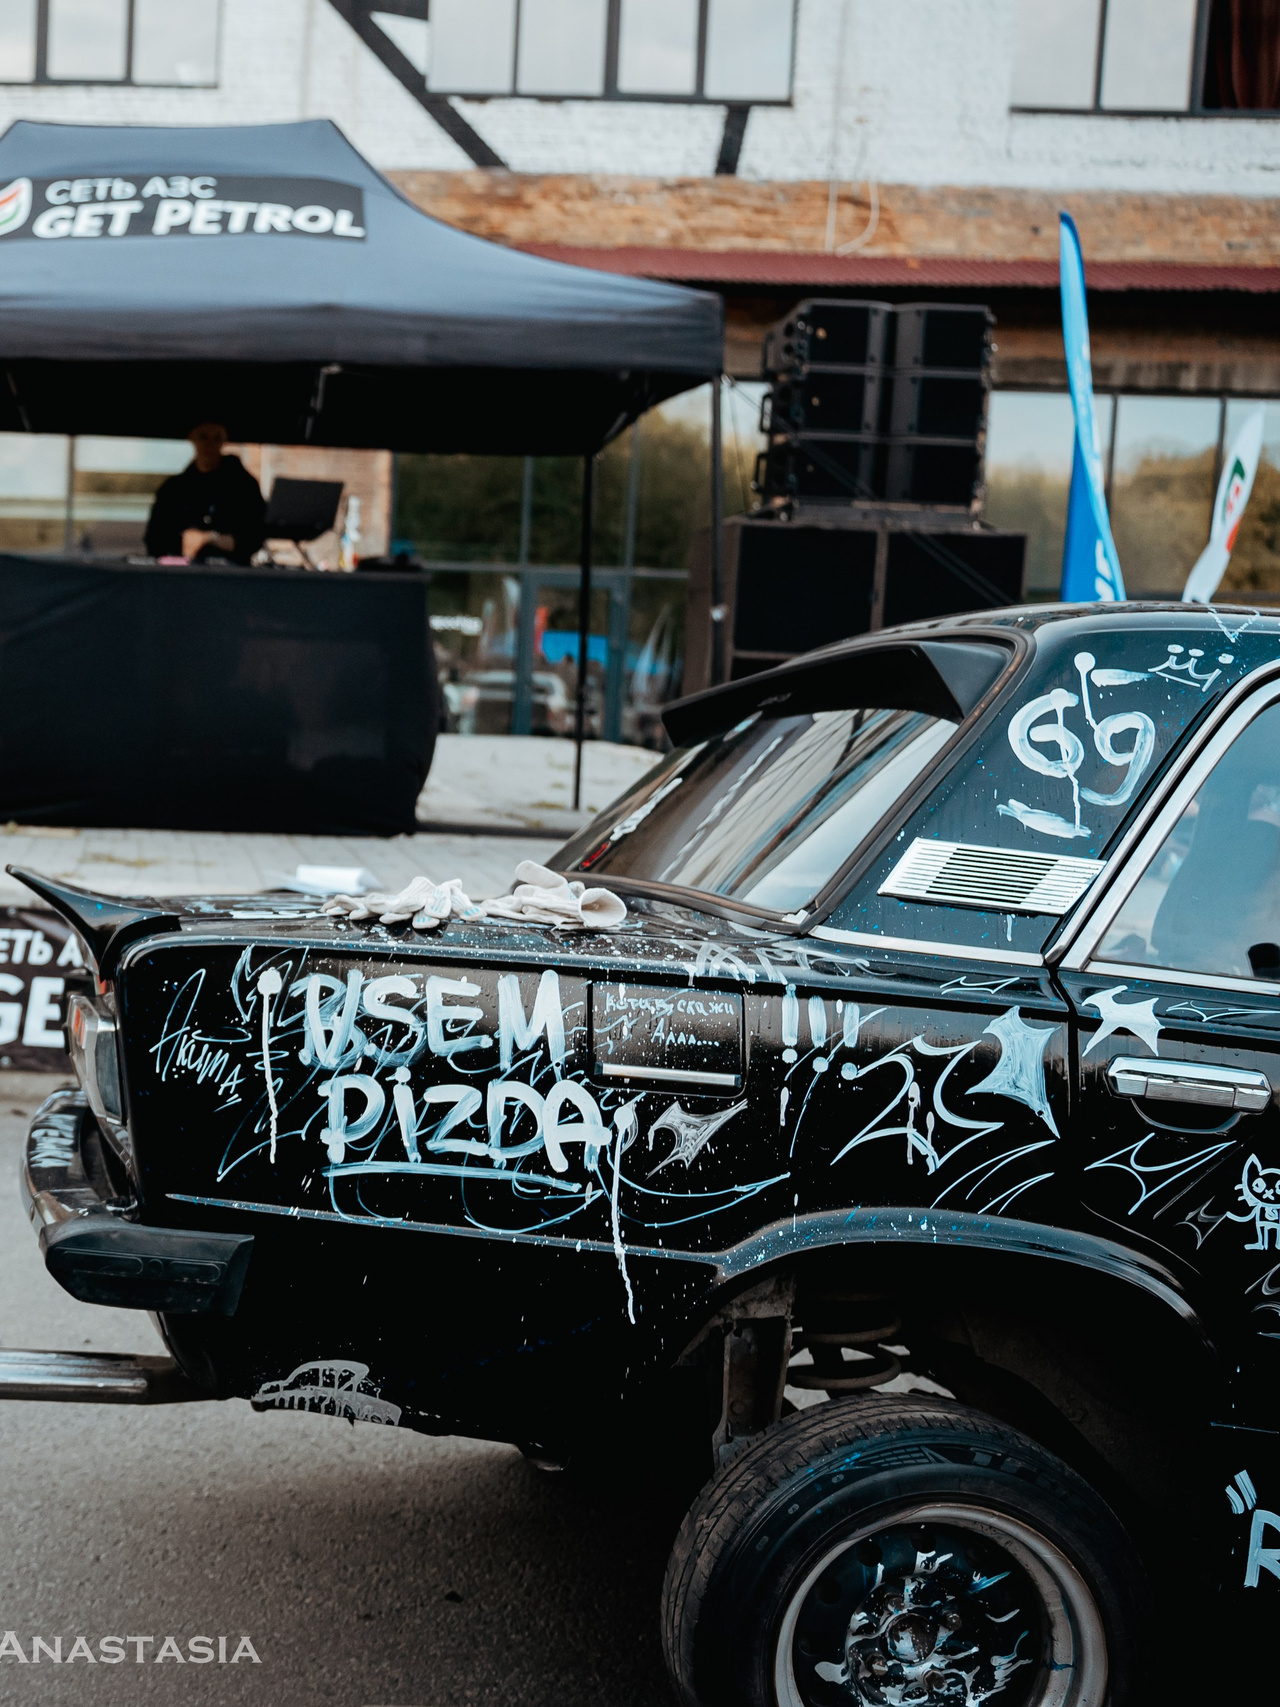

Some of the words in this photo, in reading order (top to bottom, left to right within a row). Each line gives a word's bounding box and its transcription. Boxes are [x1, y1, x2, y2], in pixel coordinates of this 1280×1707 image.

[45, 178, 137, 205] СЕТЬ
[141, 176, 217, 199] АЗС
[32, 200, 144, 239] GET
[152, 199, 365, 238] PETROL
